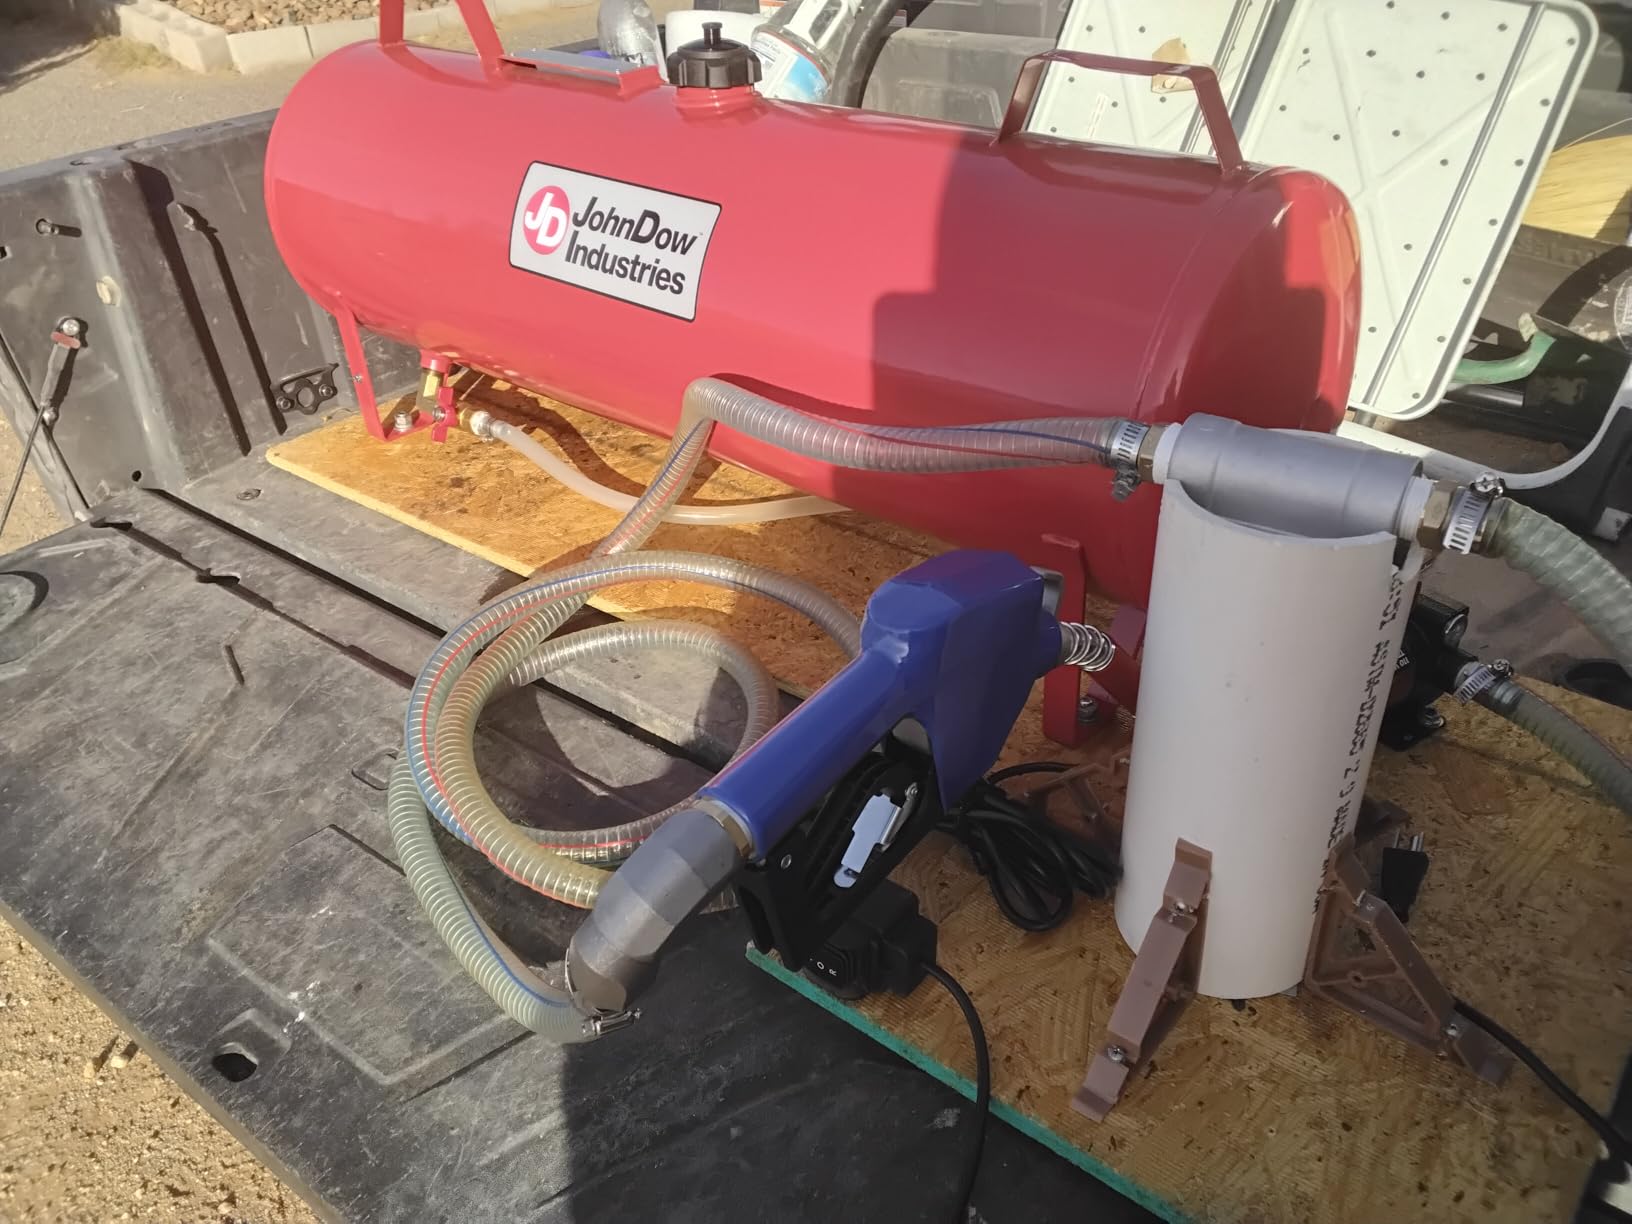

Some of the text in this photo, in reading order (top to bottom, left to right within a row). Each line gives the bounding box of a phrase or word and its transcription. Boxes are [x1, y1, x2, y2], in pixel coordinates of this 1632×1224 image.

[524, 191, 568, 248] JD
[571, 196, 698, 256] JohnDow
[564, 230, 686, 295] Industries
